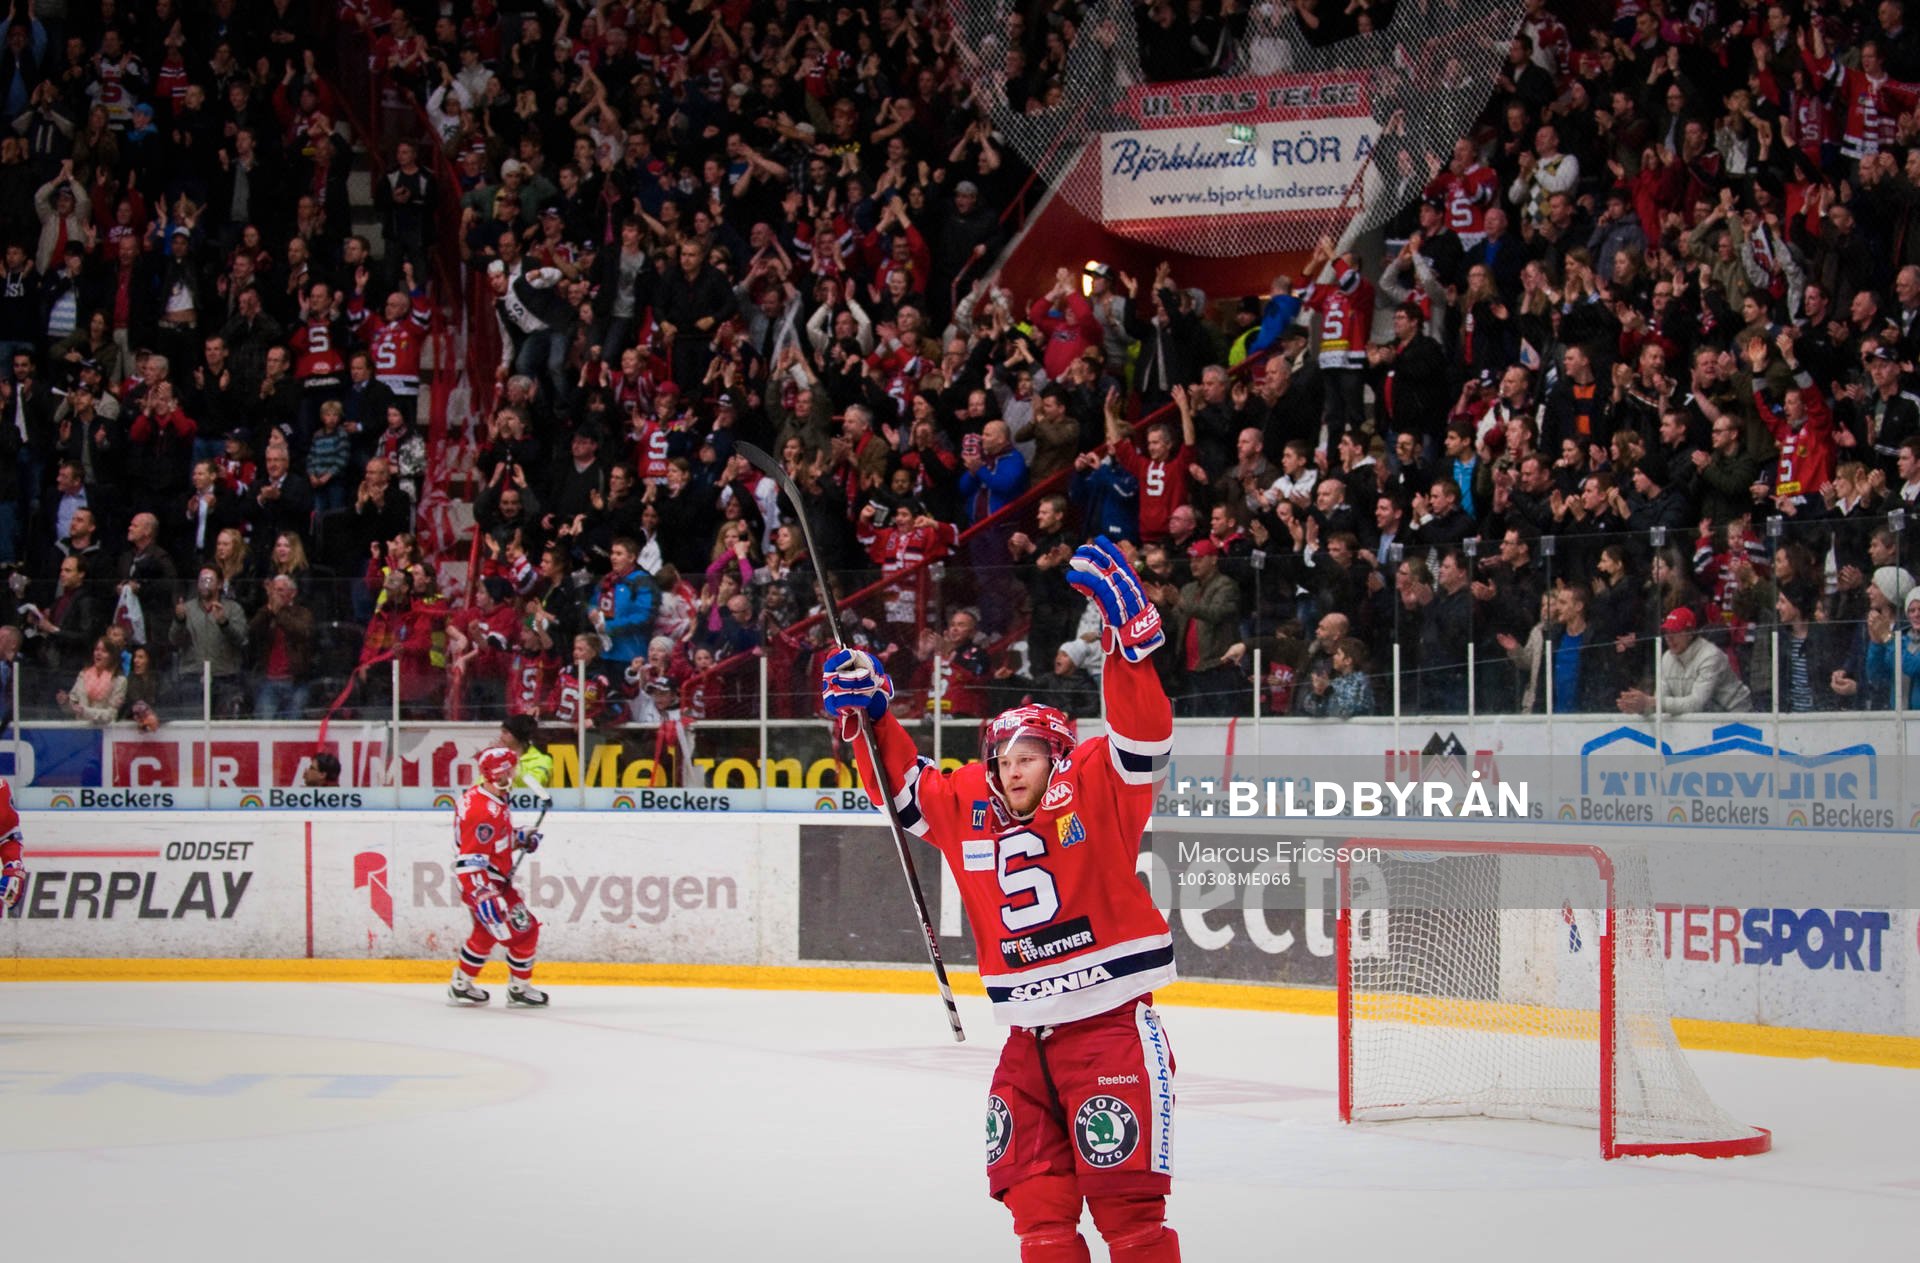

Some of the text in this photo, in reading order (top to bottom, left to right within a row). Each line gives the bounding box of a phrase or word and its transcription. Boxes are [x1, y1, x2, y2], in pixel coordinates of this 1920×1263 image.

[1271, 130, 1341, 165] RÖR
[1150, 179, 1362, 206] www.bjorklundsror.s
[1322, 309, 1344, 340] S
[307, 326, 330, 353] S
[375, 341, 397, 369] S
[648, 430, 669, 459] S
[1146, 469, 1165, 497] S
[80, 789, 174, 808] Beckers
[269, 789, 362, 808] Beckers
[641, 791, 730, 811] Beckers
[1045, 783, 1071, 807] AXA
[972, 809, 986, 827] LT
[1580, 798, 1653, 823] Beckers
[1691, 800, 1769, 825] Beckers
[1812, 803, 1894, 828] Beckers
[166, 841, 254, 860] ODDSET
[412, 861, 737, 924] Rbyggen
[998, 832, 1059, 930] S
[1001, 937, 1034, 954] OFFICE
[1007, 965, 1113, 1001] SCANIA
[1098, 1074, 1140, 1086] Reebok
[1143, 1009, 1171, 1172] Handelsbanken
[1088, 1150, 1123, 1163] AUTO
